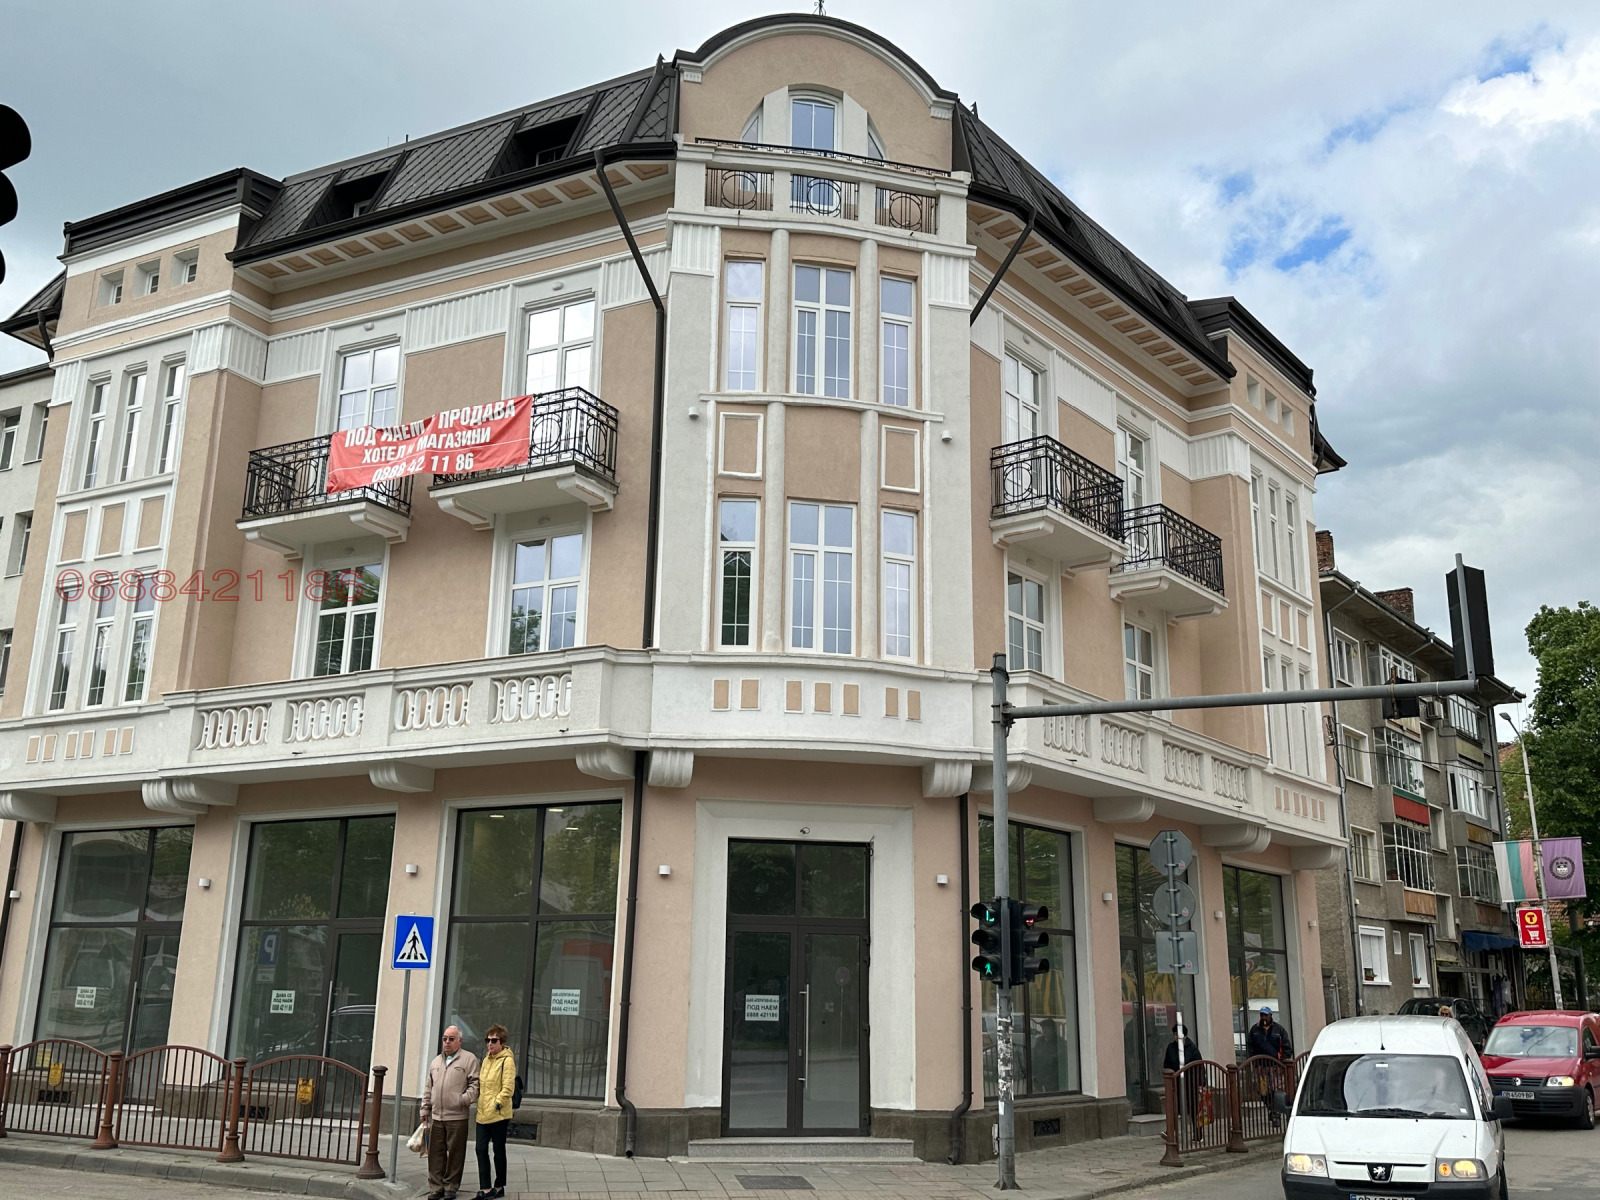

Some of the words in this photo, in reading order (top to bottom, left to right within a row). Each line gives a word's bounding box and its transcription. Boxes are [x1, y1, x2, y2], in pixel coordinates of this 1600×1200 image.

[345, 427, 376, 447] ПОД
[438, 400, 516, 429] ПРОДАВА
[362, 443, 406, 463] ХОТЕЛ
[407, 444, 416, 454] и
[416, 427, 491, 451] МАГАЗИНИ
[372, 463, 406, 483] 0888
[407, 456, 425, 472] 42
[431, 455, 449, 472] 11
[456, 453, 474, 471] 86
